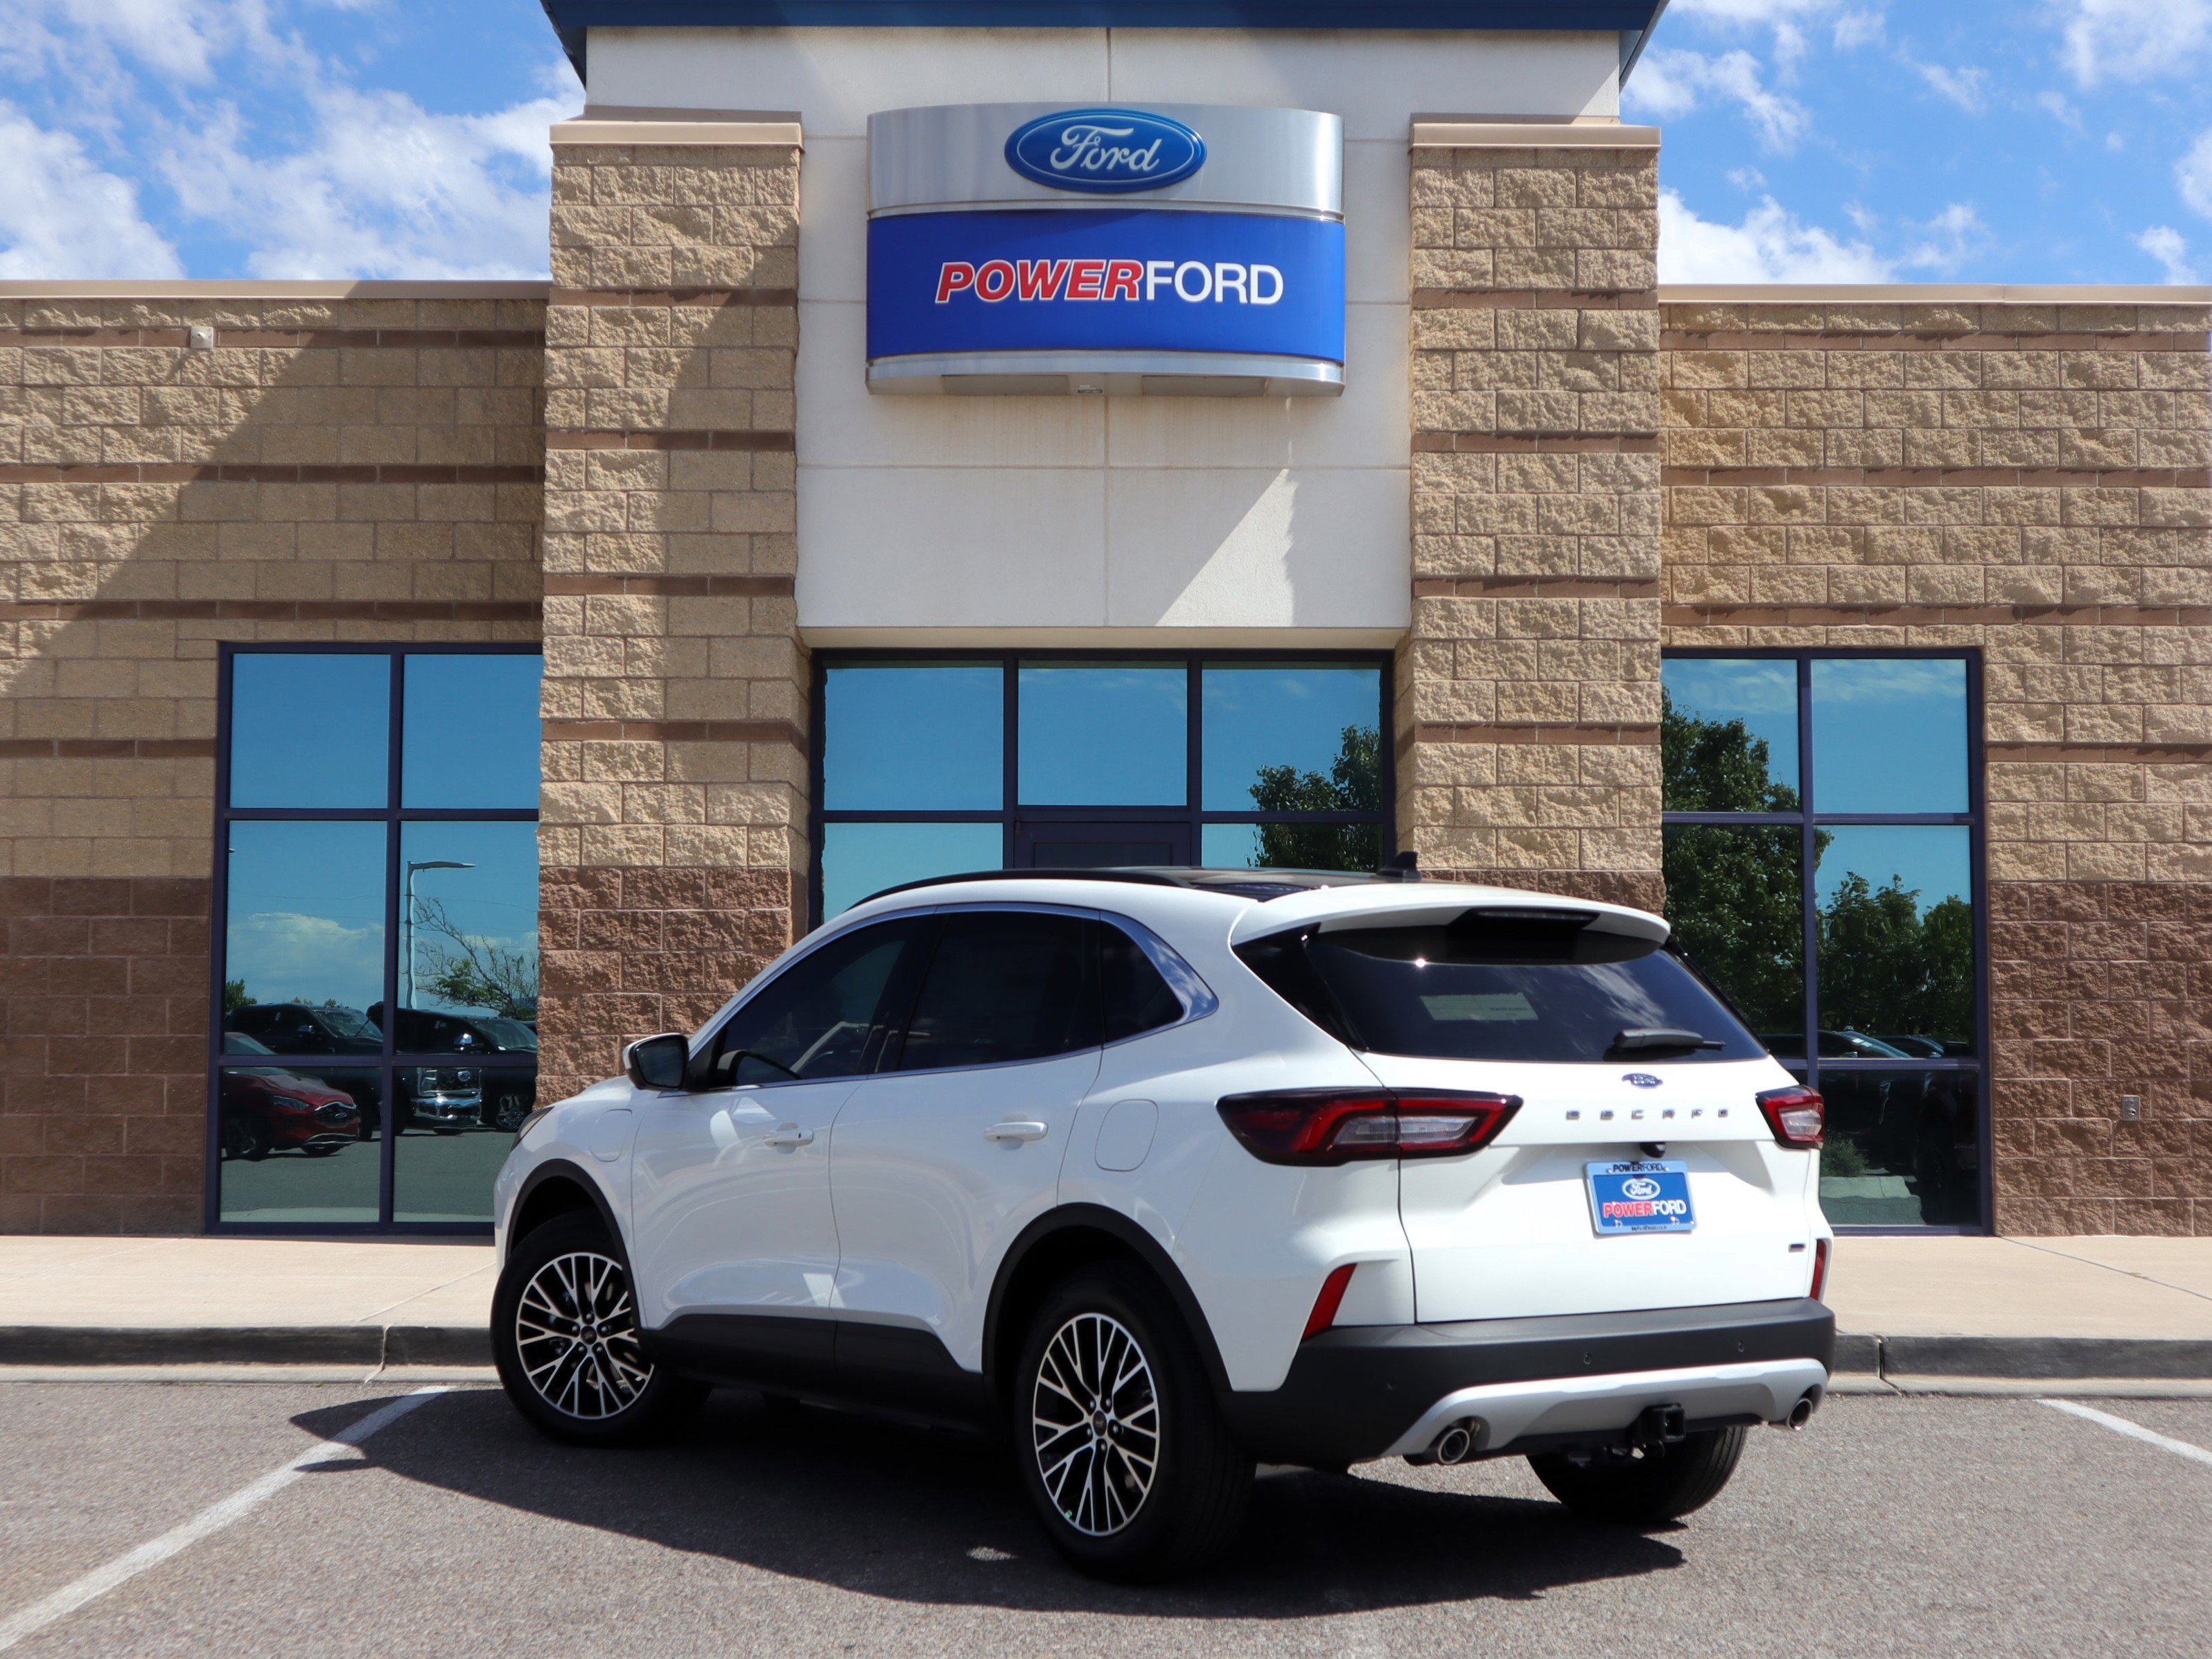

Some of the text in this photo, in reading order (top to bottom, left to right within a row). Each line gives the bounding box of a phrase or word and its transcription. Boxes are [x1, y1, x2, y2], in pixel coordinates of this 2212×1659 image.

[1050, 124, 1161, 171] Ford
[934, 258, 1283, 304] POWERFORD
[1629, 1181, 1653, 1195] Ford
